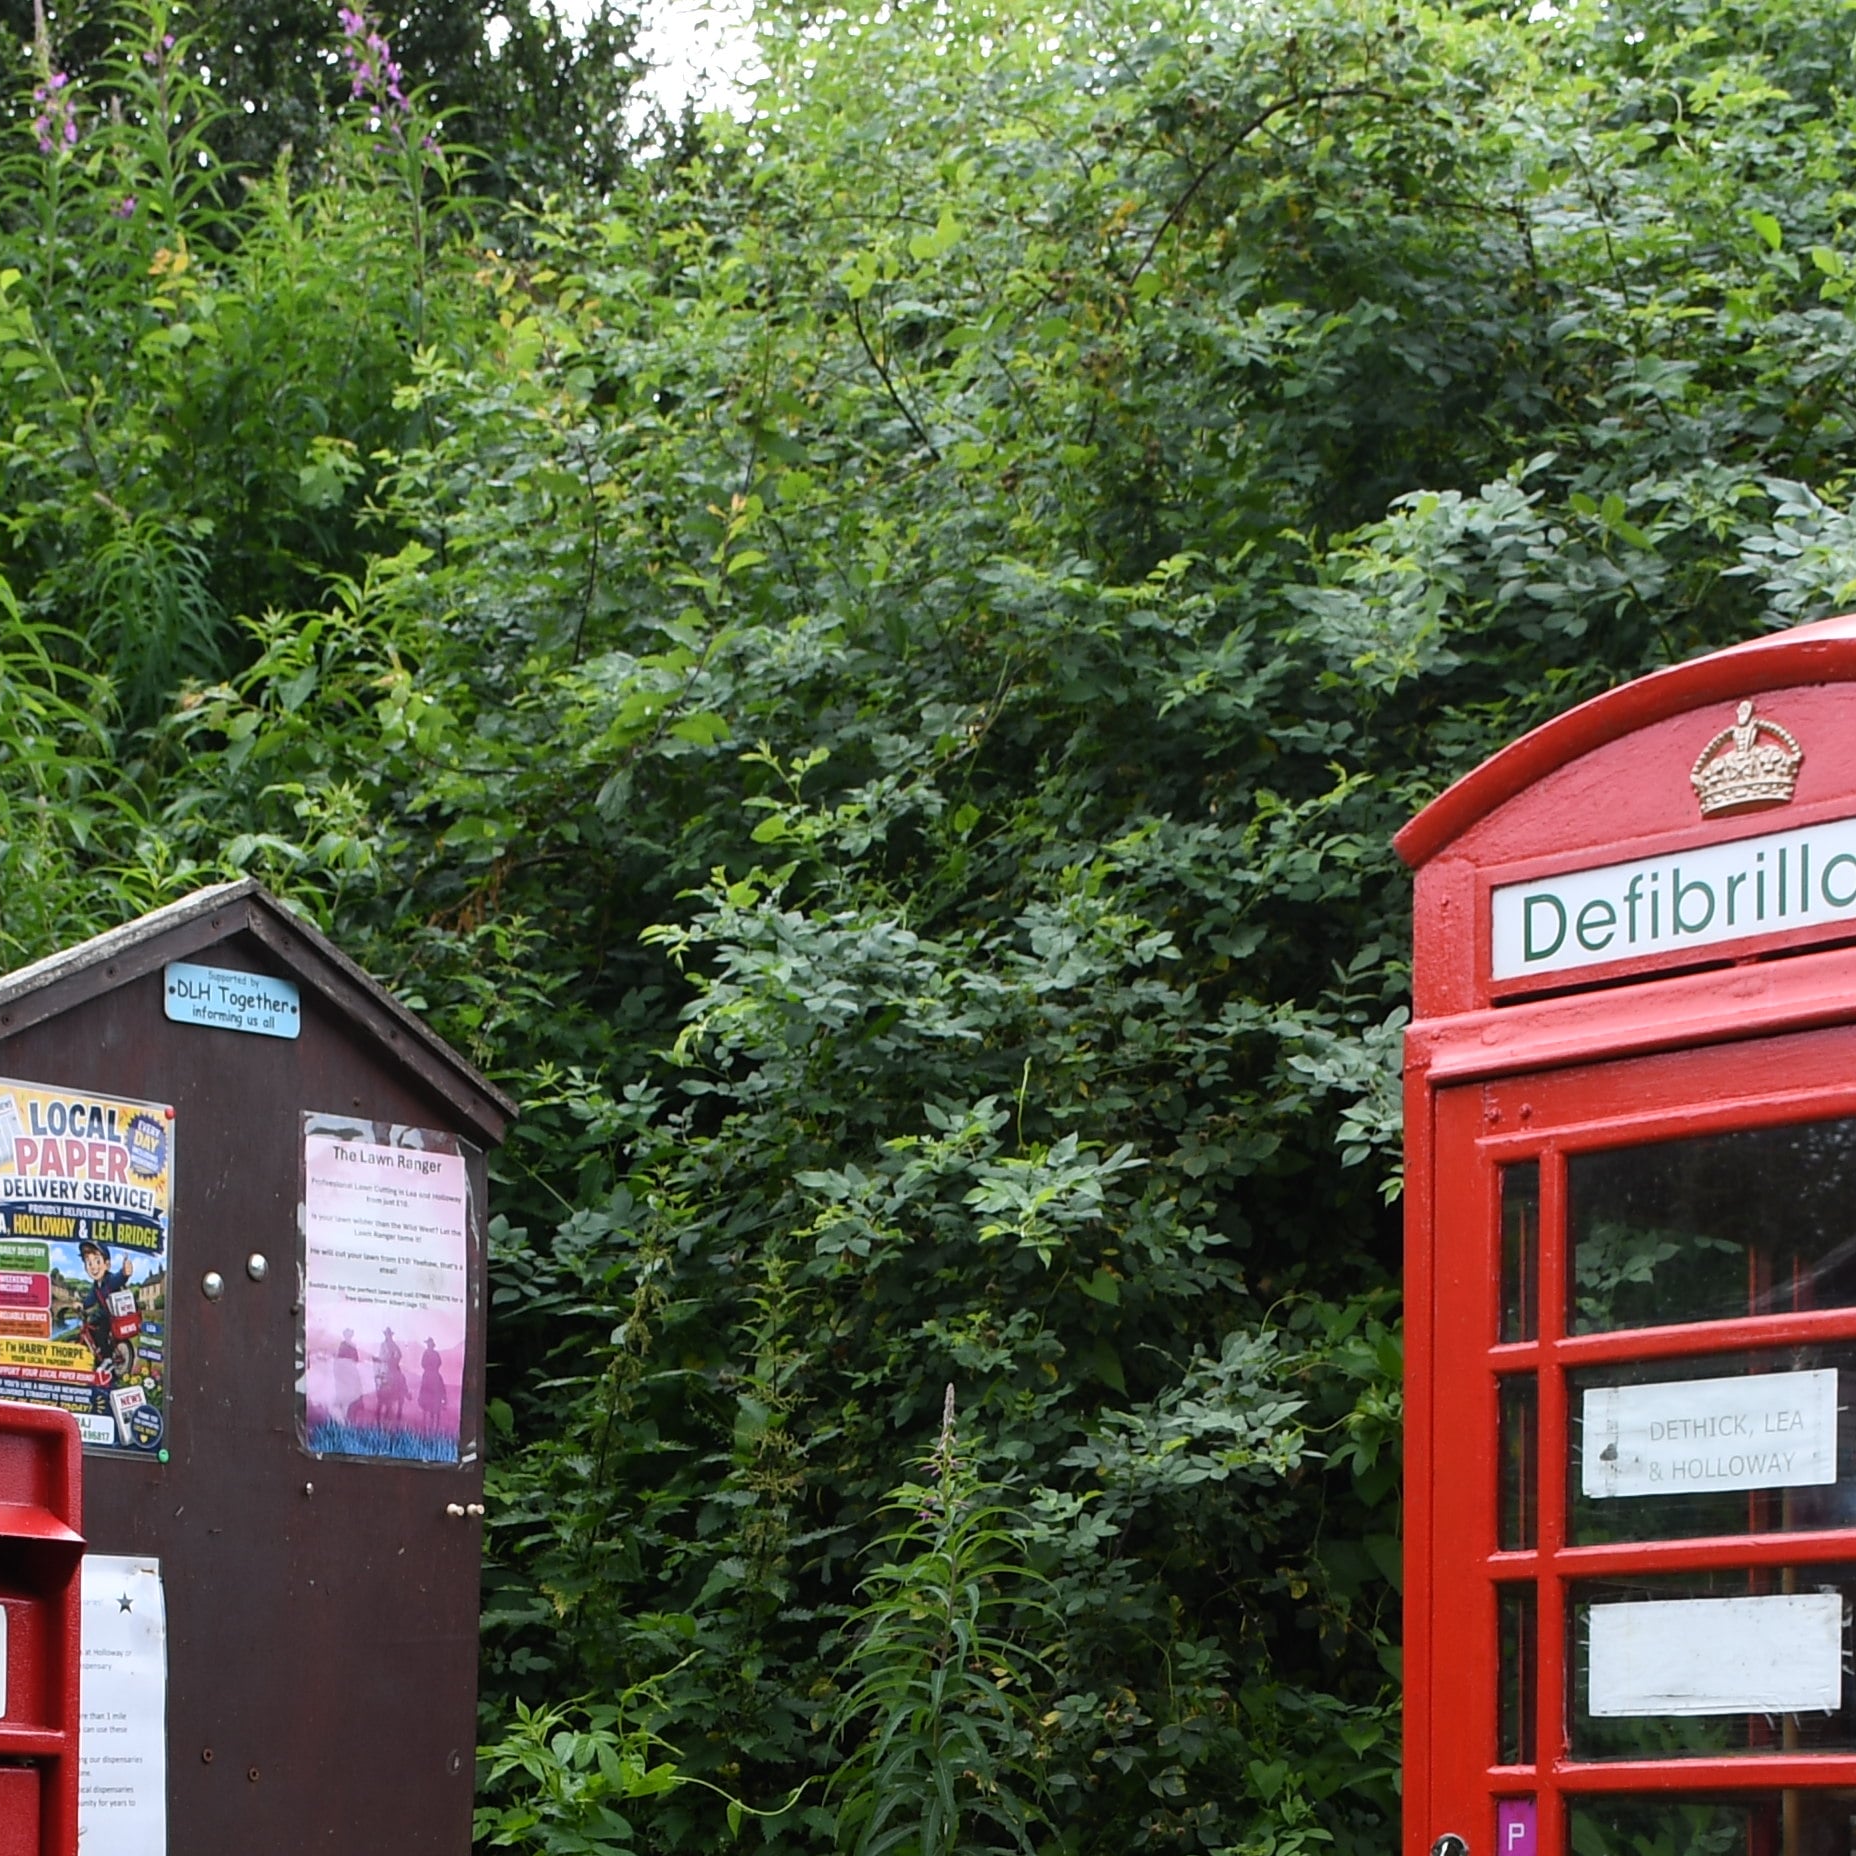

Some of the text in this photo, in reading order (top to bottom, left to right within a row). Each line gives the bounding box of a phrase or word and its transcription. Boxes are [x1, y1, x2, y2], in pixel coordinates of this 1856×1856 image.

[208, 971, 259, 988] Supported by
[178, 979, 289, 1013] DLH Together
[192, 1004, 275, 1028] informing us all
[30, 1102, 122, 1142] LOCAL
[138, 1121, 160, 1136] EVERY
[134, 1131, 159, 1151] DAY
[15, 1138, 128, 1184] PAPER
[333, 1146, 442, 1174] The Lawn Ranger
[4, 1179, 153, 1211] DELIVERY SERVICE!
[374, 1185, 397, 1197] Cutting
[28, 1204, 115, 1221] PROUDLY DELIVERING IN
[14, 1214, 76, 1238] HOLLOWAY
[79, 1220, 88, 1239] &
[92, 1222, 113, 1241] LEA
[117, 1226, 158, 1248] BRIDGE
[374, 1232, 396, 1241] Ranger
[19, 1344, 48, 1355] HARRY
[51, 1346, 84, 1359] THORPE
[22, 1367, 38, 1376] YOUR
[39, 1369, 57, 1378] LOCAL
[58, 1370, 75, 1379] PAPER
[120, 1393, 142, 1406] NEWS
[1650, 1410, 1804, 1441] DETHICK, LEA
[1649, 1452, 1795, 1481] & HOLLOWAY
[93, 1649, 123, 1657] Holloway
[82, 1663, 111, 1671] spensary
[109, 1726, 127, 1734] these
[102, 1757, 143, 1765] dispensaries
[94, 1786, 134, 1794] dispensaries
[109, 1800, 127, 1808] years
